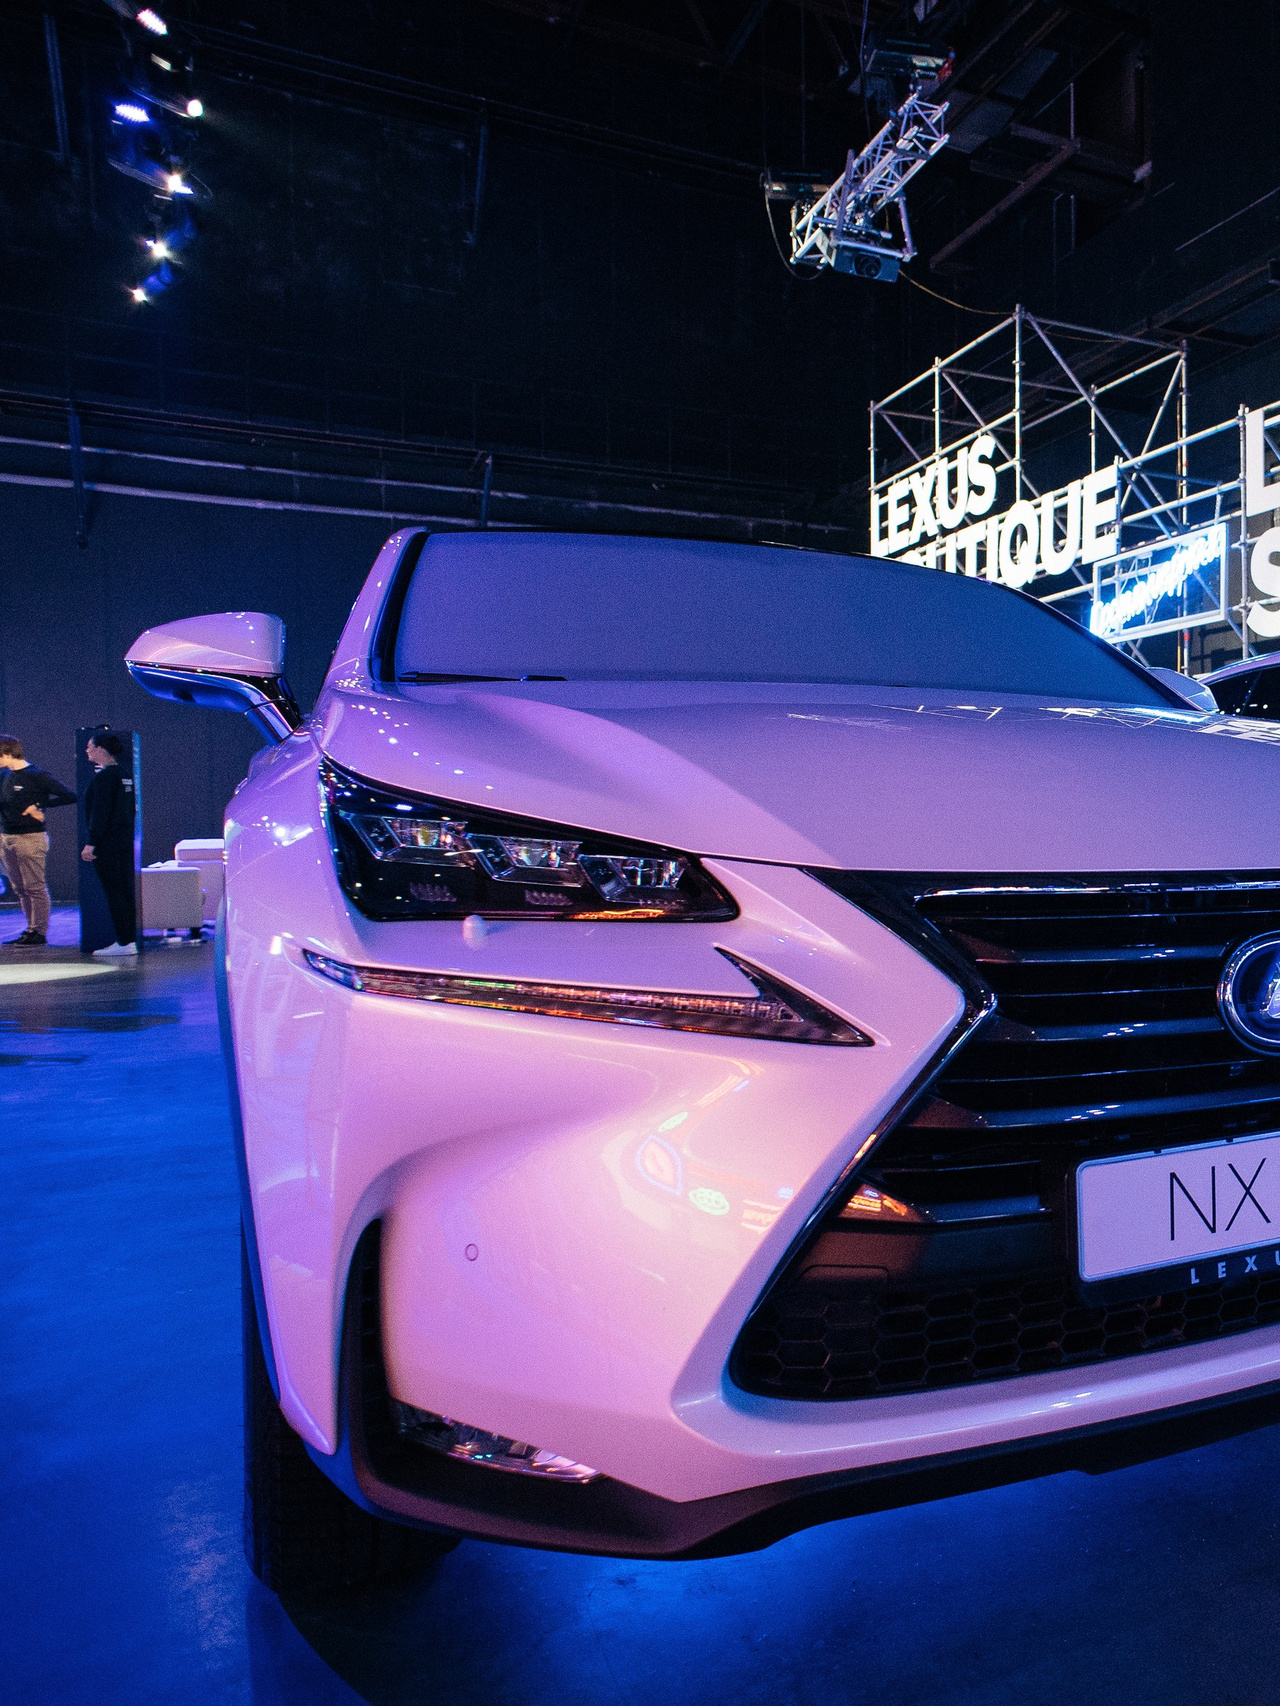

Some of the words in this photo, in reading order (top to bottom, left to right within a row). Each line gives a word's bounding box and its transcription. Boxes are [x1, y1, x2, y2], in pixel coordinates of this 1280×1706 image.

[871, 434, 997, 557] LEXUS
[893, 463, 1118, 588] TIQUE
[1169, 1157, 1271, 1241] NX
